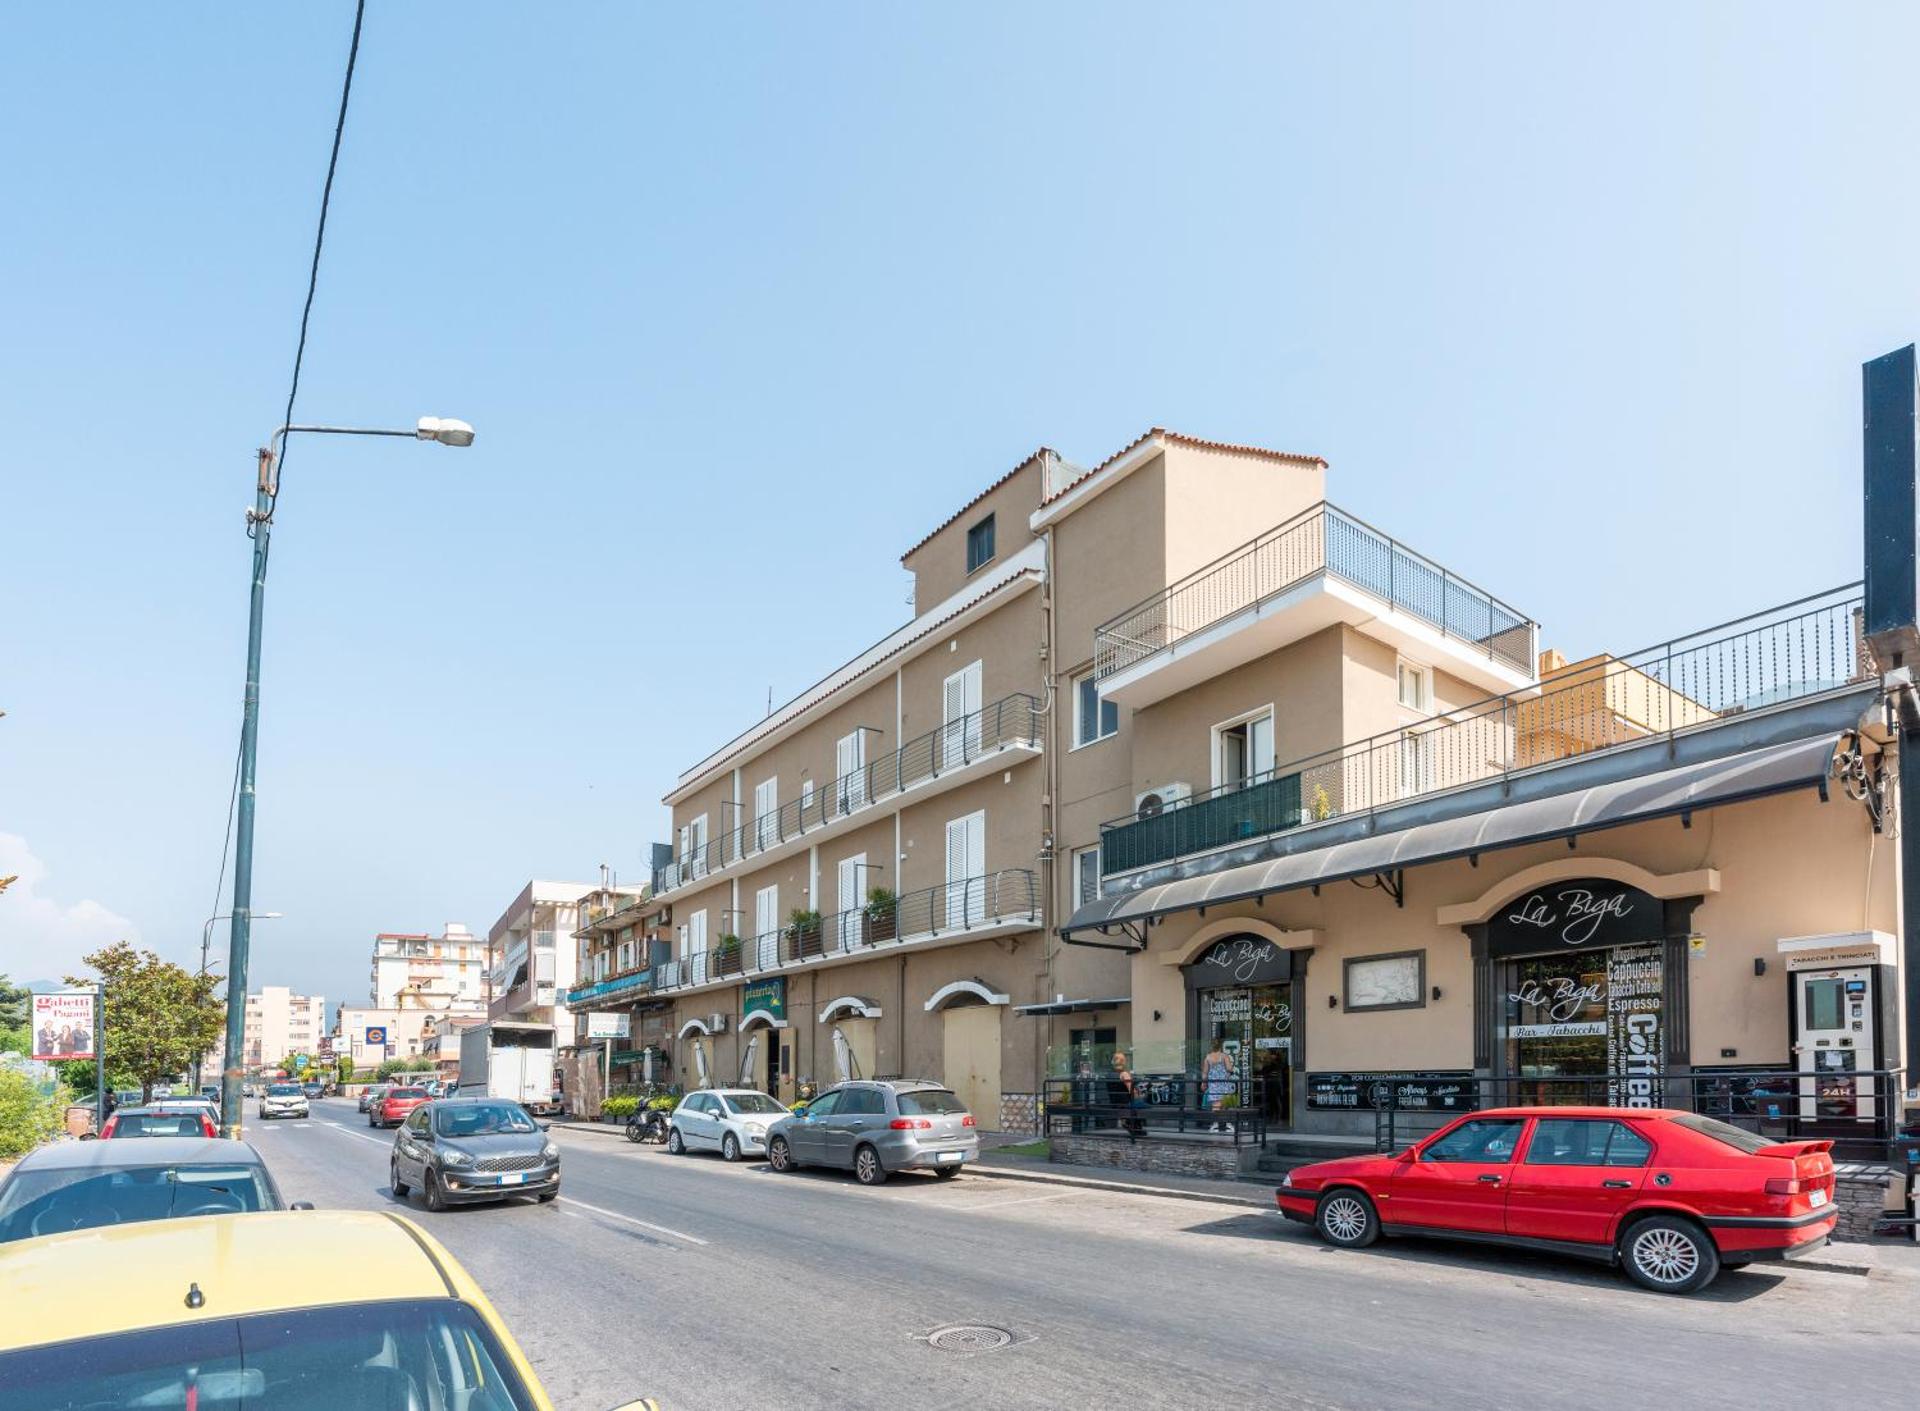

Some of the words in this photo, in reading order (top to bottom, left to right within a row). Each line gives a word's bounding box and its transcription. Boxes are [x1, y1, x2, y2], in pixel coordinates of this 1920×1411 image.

[1508, 894, 1556, 927] La
[1558, 889, 1634, 944] Biga
[1205, 943, 1233, 967] La
[1233, 940, 1276, 981] Biga
[1792, 955, 1829, 963] TABACCHI
[1509, 980, 1547, 1006] La
[1547, 977, 1606, 1021] Biga
[1608, 998, 1660, 1013] Espresso
[1513, 1027, 1537, 1037] Bar
[1547, 1023, 1601, 1037] Tabacchi
